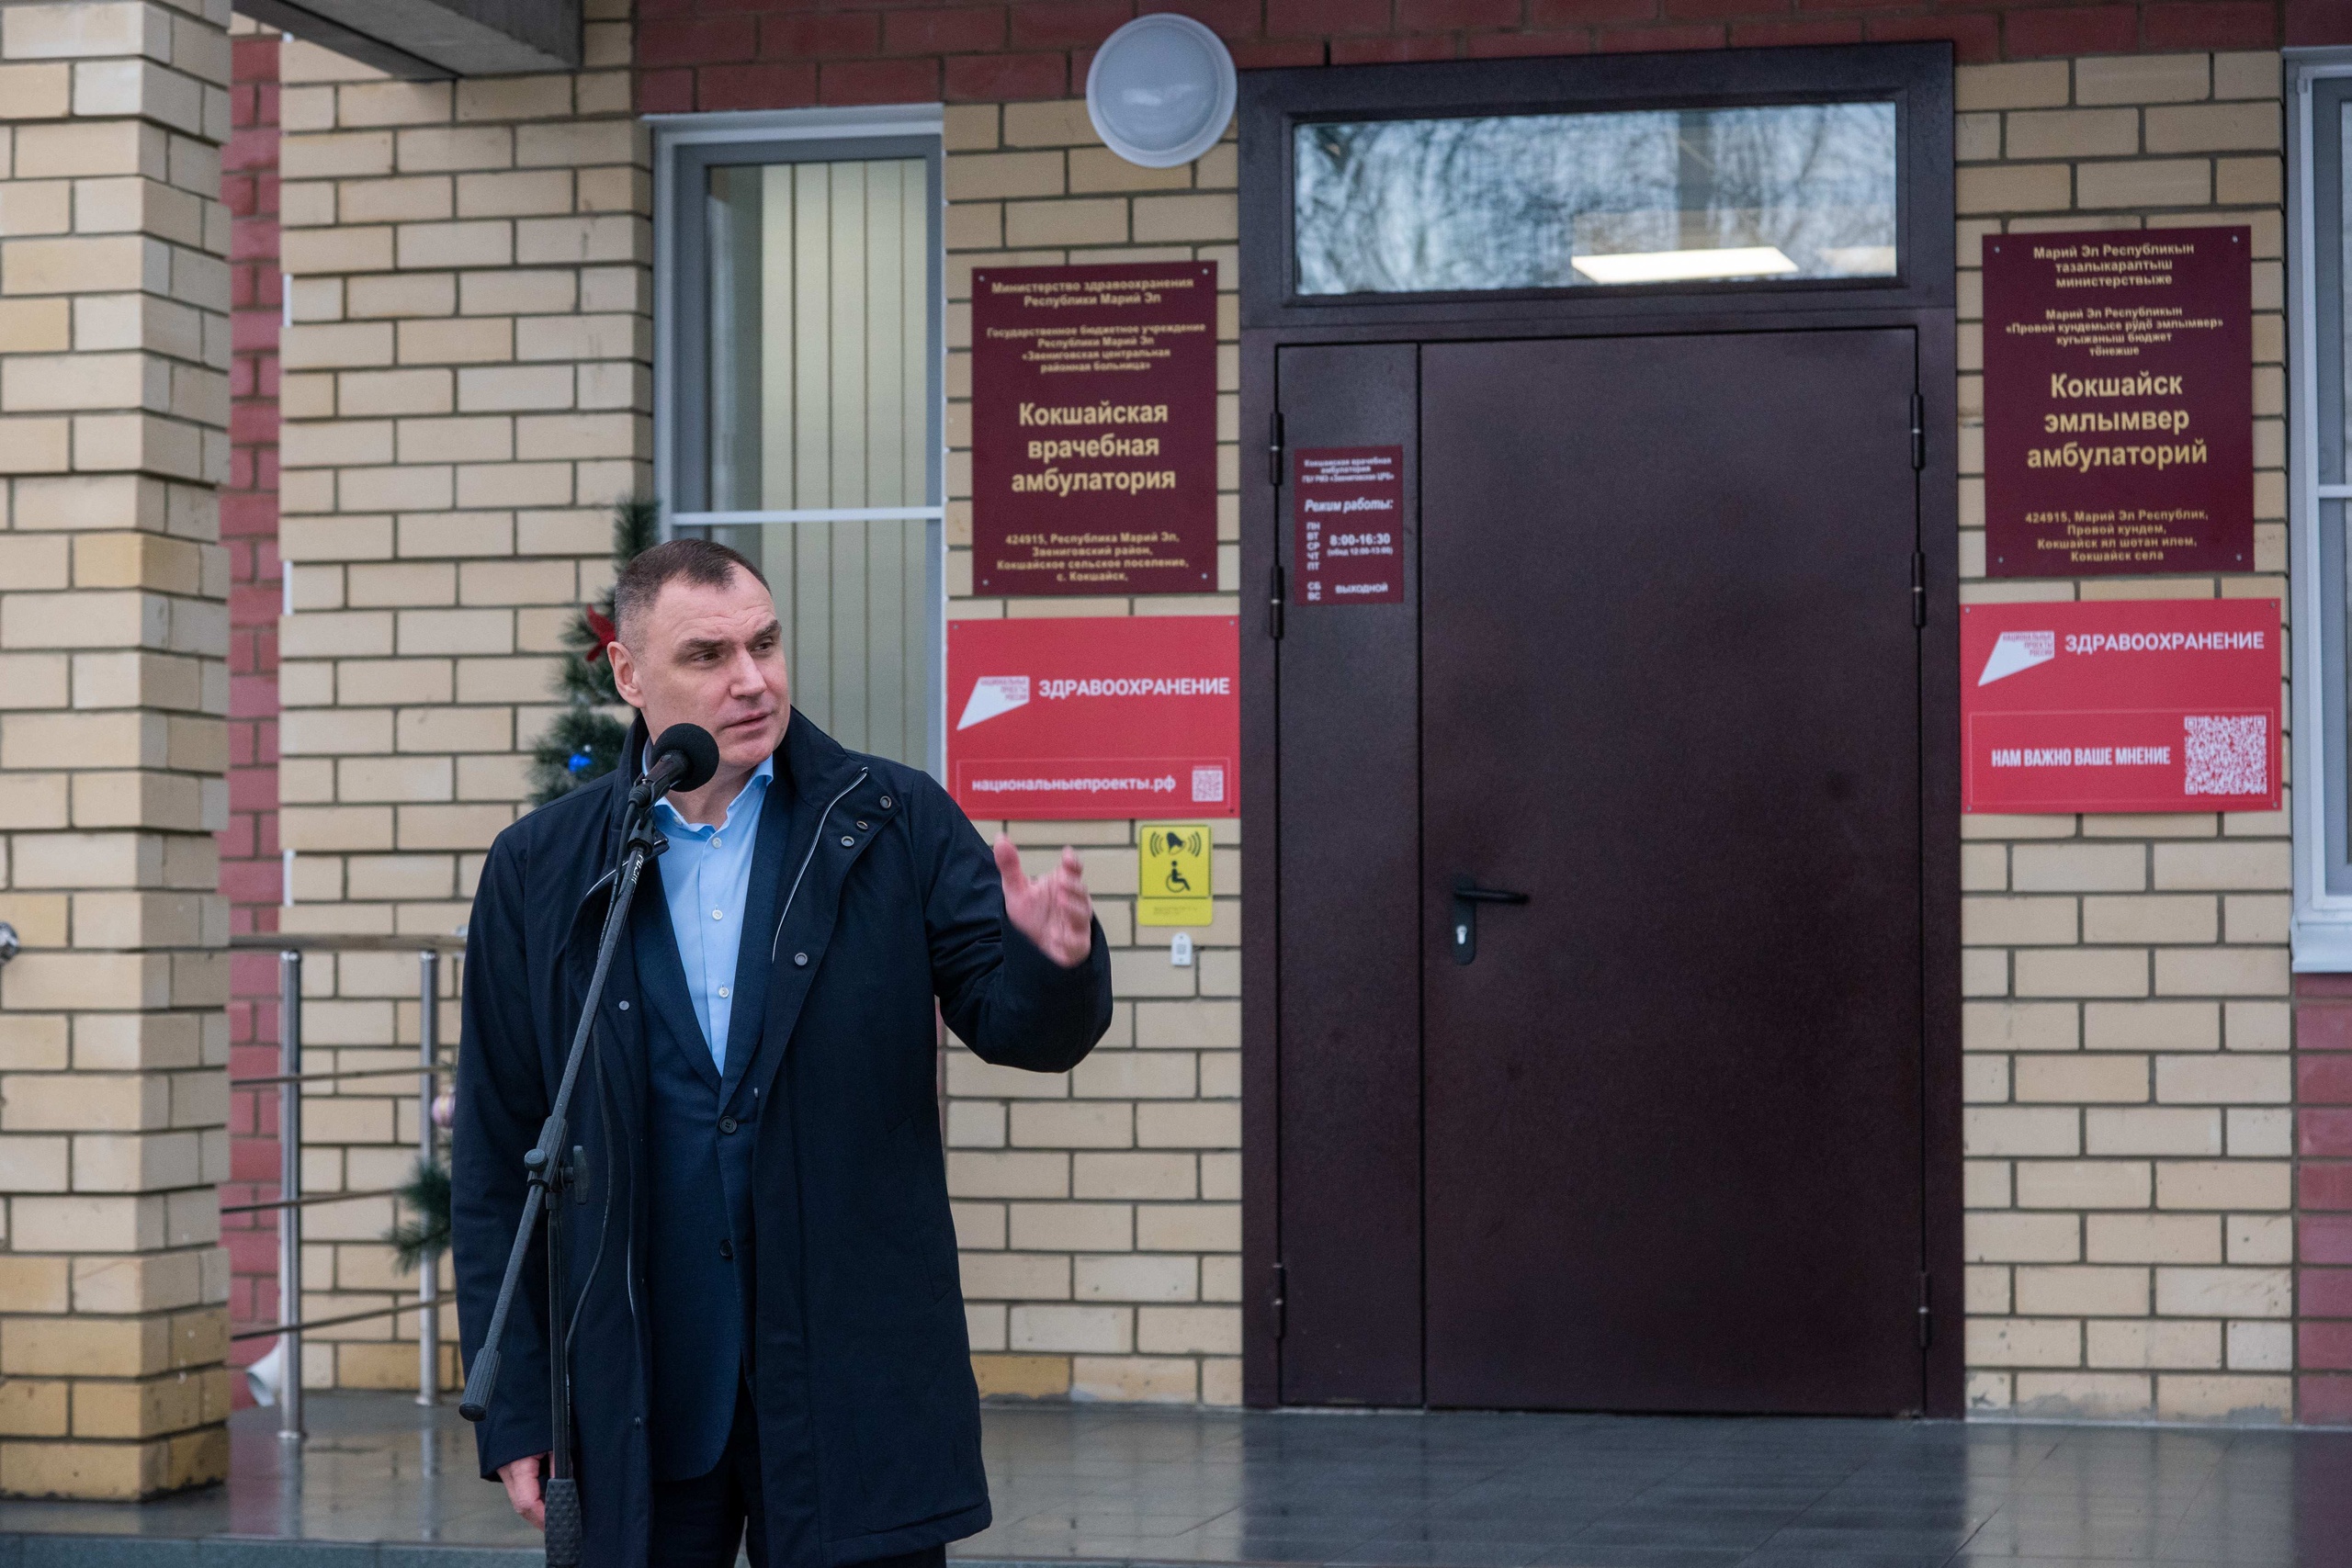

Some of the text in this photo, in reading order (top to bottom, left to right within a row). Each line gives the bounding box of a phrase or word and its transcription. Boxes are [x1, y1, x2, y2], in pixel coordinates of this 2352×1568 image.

[2033, 243, 2195, 260] Марий Эл Республикын
[2055, 259, 2173, 274] тазалыкаралтыш
[991, 278, 1194, 294] Министерство здравоохранения
[2055, 275, 2173, 289] министерствыже
[1023, 292, 1161, 309] Республики Марий Эл
[2045, 306, 2183, 321] Марий Эл Республикын
[987, 323, 1206, 339] Государственное бюджетное учреждение
[2006, 322, 2055, 336] «Провой
[2058, 321, 2122, 335] кундемысе
[1037, 335, 1155, 349] Республики Марий Эл
[2056, 332, 2173, 347] кугыжаныш бюджет
[1022, 349, 1171, 361] «Звениговская центральная
[1040, 361, 1151, 374] районная больница»
[2051, 370, 2183, 399] Кокшайск
[1019, 400, 1169, 426] Кокшайская
[2044, 410, 2189, 435] эмлымвер
[1028, 433, 1160, 464] врачебная
[2027, 438, 2208, 473] амбулаторий
[1012, 467, 1176, 497] амбулатория
[1305, 497, 1394, 513] Режим работы:
[2025, 508, 2209, 525] 424915, Марий Эл Республик,
[1306, 521, 1321, 530] ПН
[2067, 523, 2166, 537] Провой кундем,
[1005, 531, 1180, 546] 424915, Республика Марий Эл,
[1306, 531, 1319, 541] ВТ
[1329, 533, 1391, 547] 8:00-16:30
[2037, 536, 2197, 550] Кокшайск ял шотан илем,
[1032, 545, 1153, 558] Звениговский район,
[1306, 541, 1320, 550] СР
[1306, 551, 1319, 560] ЧТ
[2071, 549, 2165, 562] Кокшайск села
[997, 558, 1189, 570] Кокшайское сельское поселение,
[1306, 561, 1320, 570] ПТ
[1057, 571, 1128, 582] с. Кокшайск,
[1307, 581, 1321, 591] СБ
[1307, 591, 1321, 601] ВС
[2064, 631, 2265, 654] ЗДРАВООХРАНЕНИЕ
[1038, 677, 1230, 699] ЗДРАВООХРАНЕНИЕ
[1992, 746, 2171, 767] НАМ ВАЖНО ВАШЕ МНЕНИЕ
[972, 775, 1176, 793] национальныепроекты.рф
